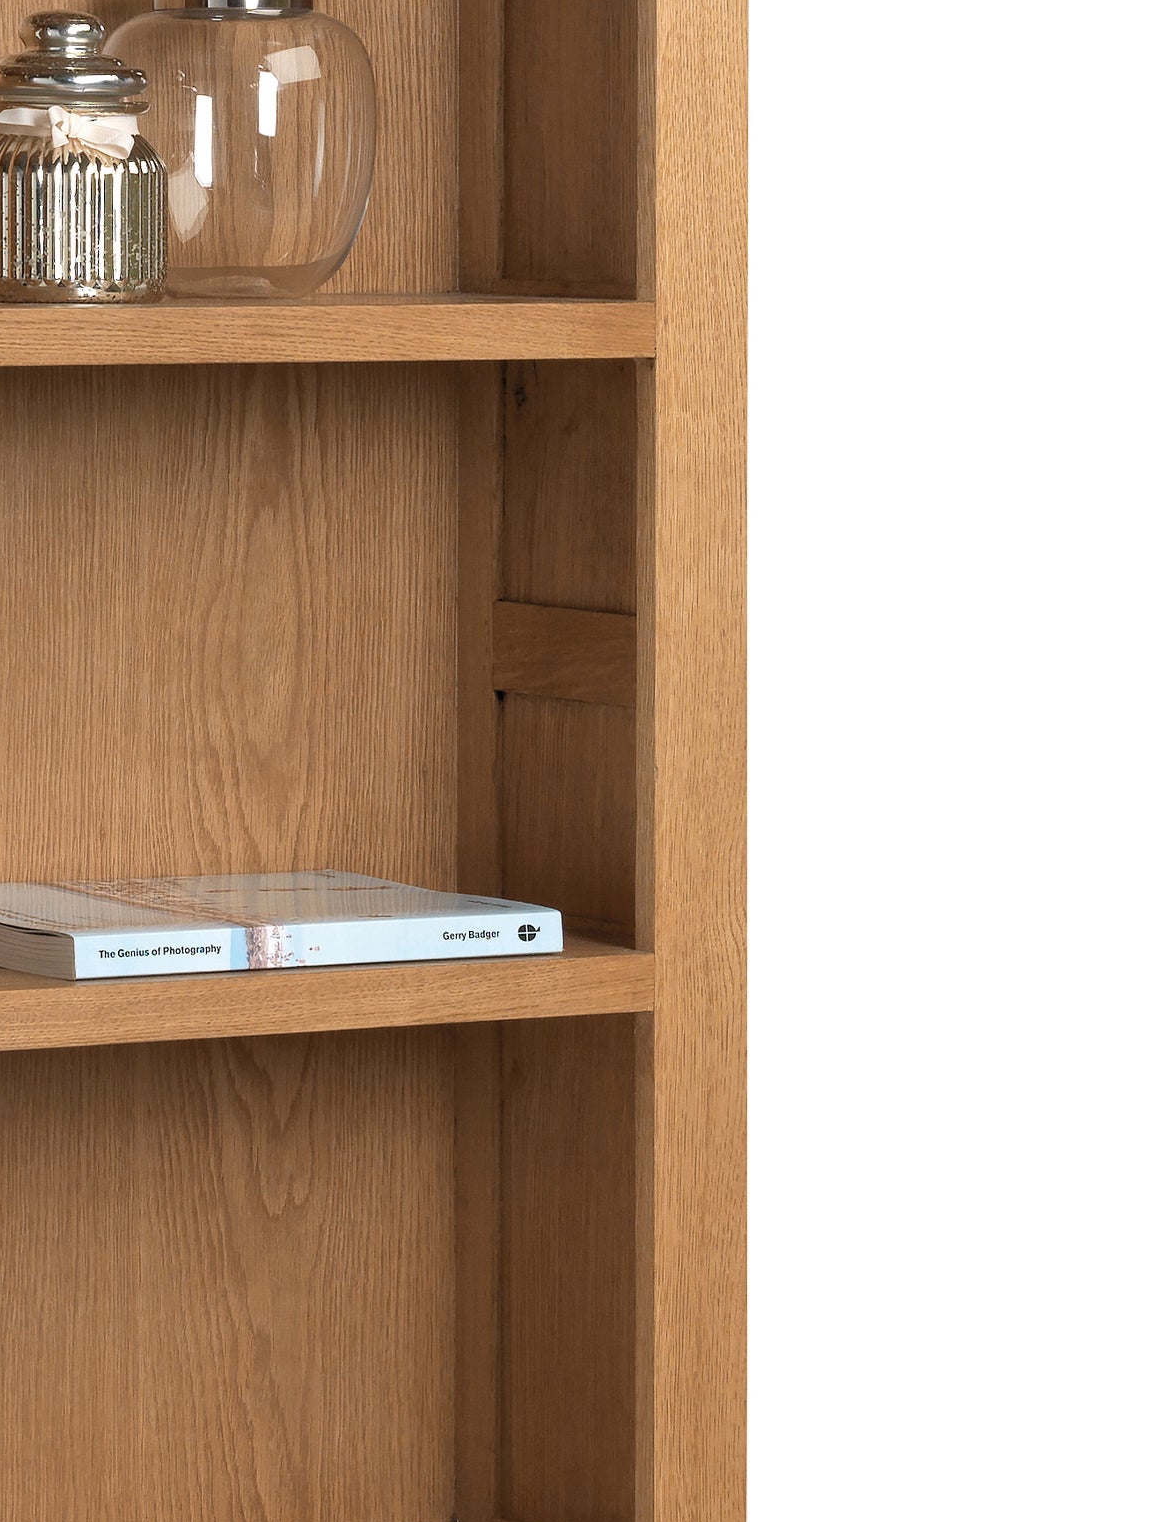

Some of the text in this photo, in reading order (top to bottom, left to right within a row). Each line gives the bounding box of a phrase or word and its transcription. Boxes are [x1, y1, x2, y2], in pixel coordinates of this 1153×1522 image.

[442, 929, 500, 941] Gerry Badger
[98, 944, 222, 959] The Genius of Photography
